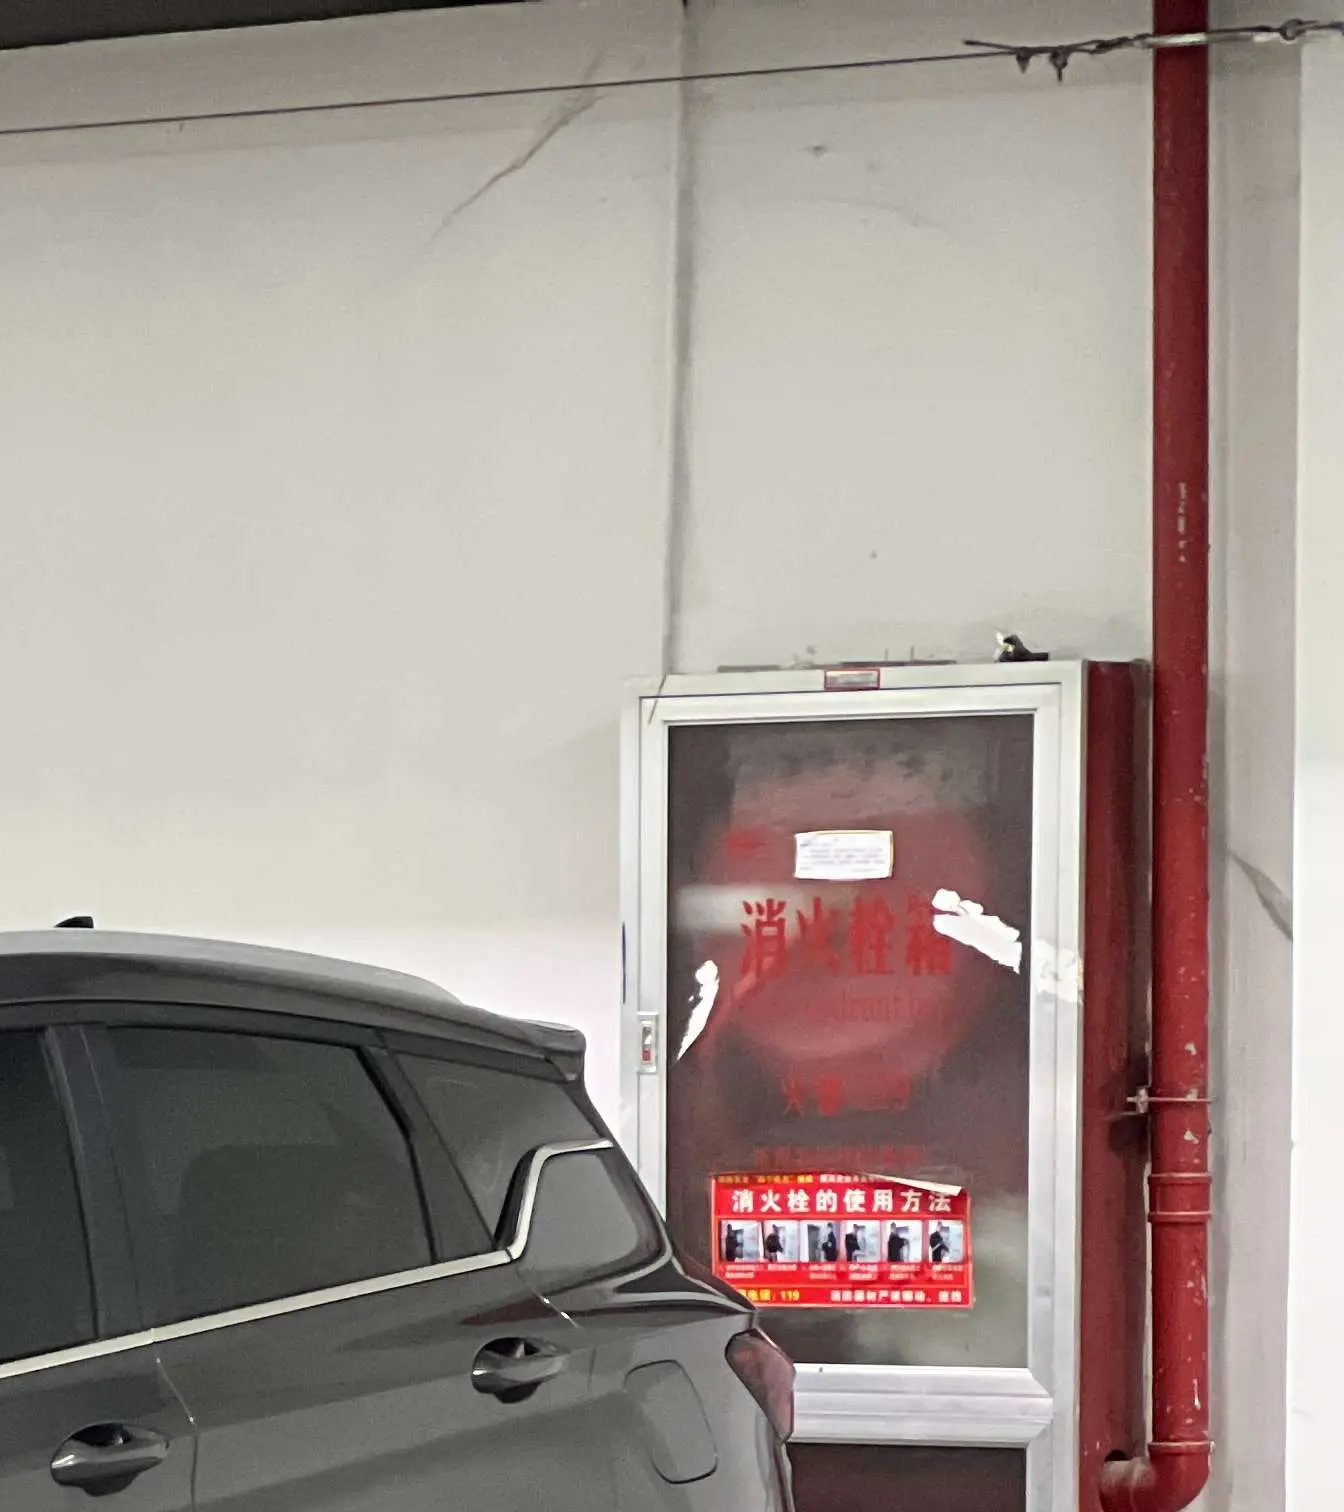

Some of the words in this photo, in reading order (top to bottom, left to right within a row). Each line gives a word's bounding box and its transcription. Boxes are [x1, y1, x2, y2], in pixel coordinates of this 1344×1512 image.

[731, 1188, 952, 1213] 消火栓的使用方法
